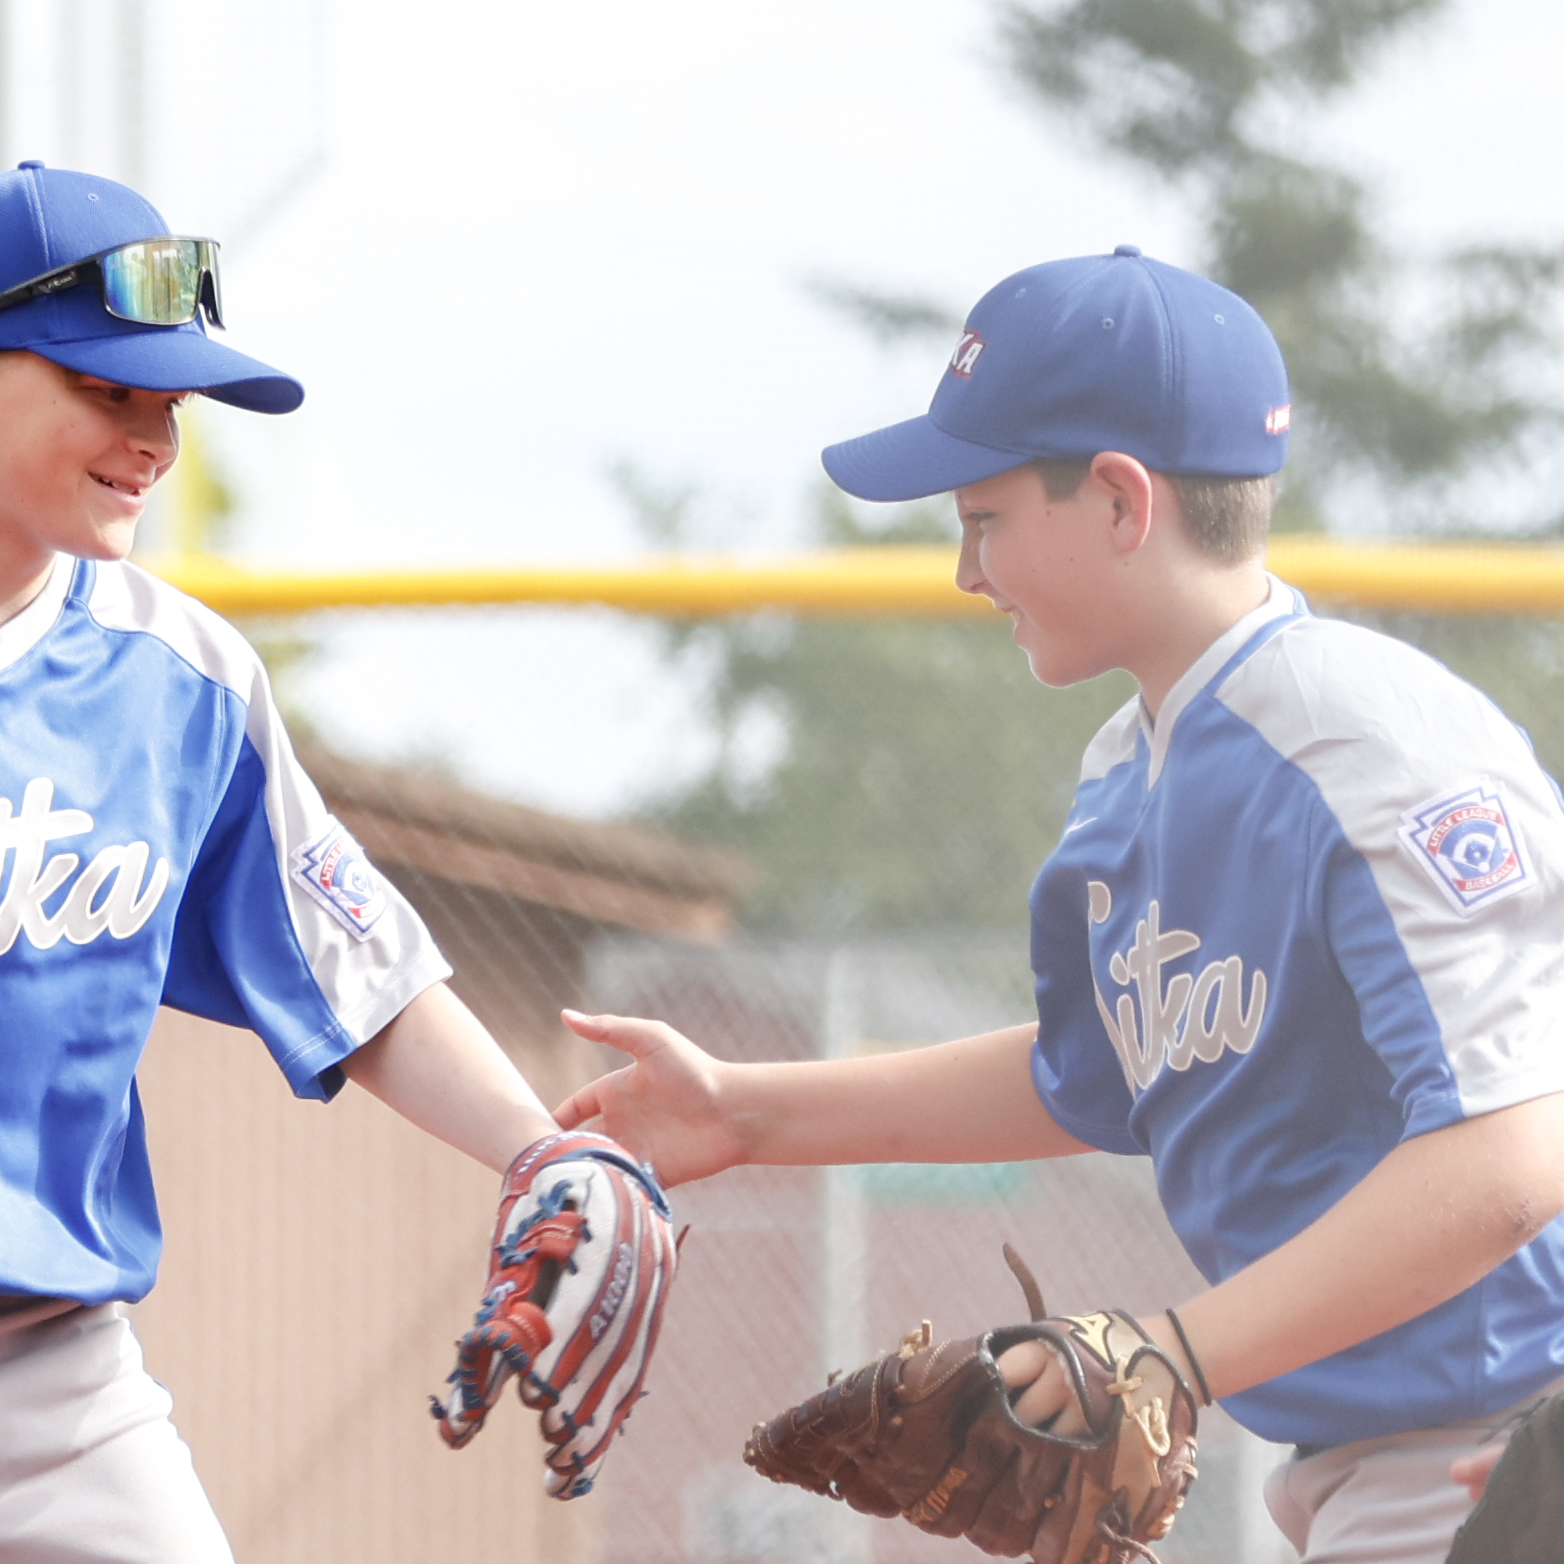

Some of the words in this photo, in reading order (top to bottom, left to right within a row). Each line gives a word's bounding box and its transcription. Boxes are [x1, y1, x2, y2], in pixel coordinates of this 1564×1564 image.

[1429, 818, 1453, 848] LITTLE
[1455, 808, 1497, 822] LEAGUE
[1465, 863, 1514, 890] BASEBALL
